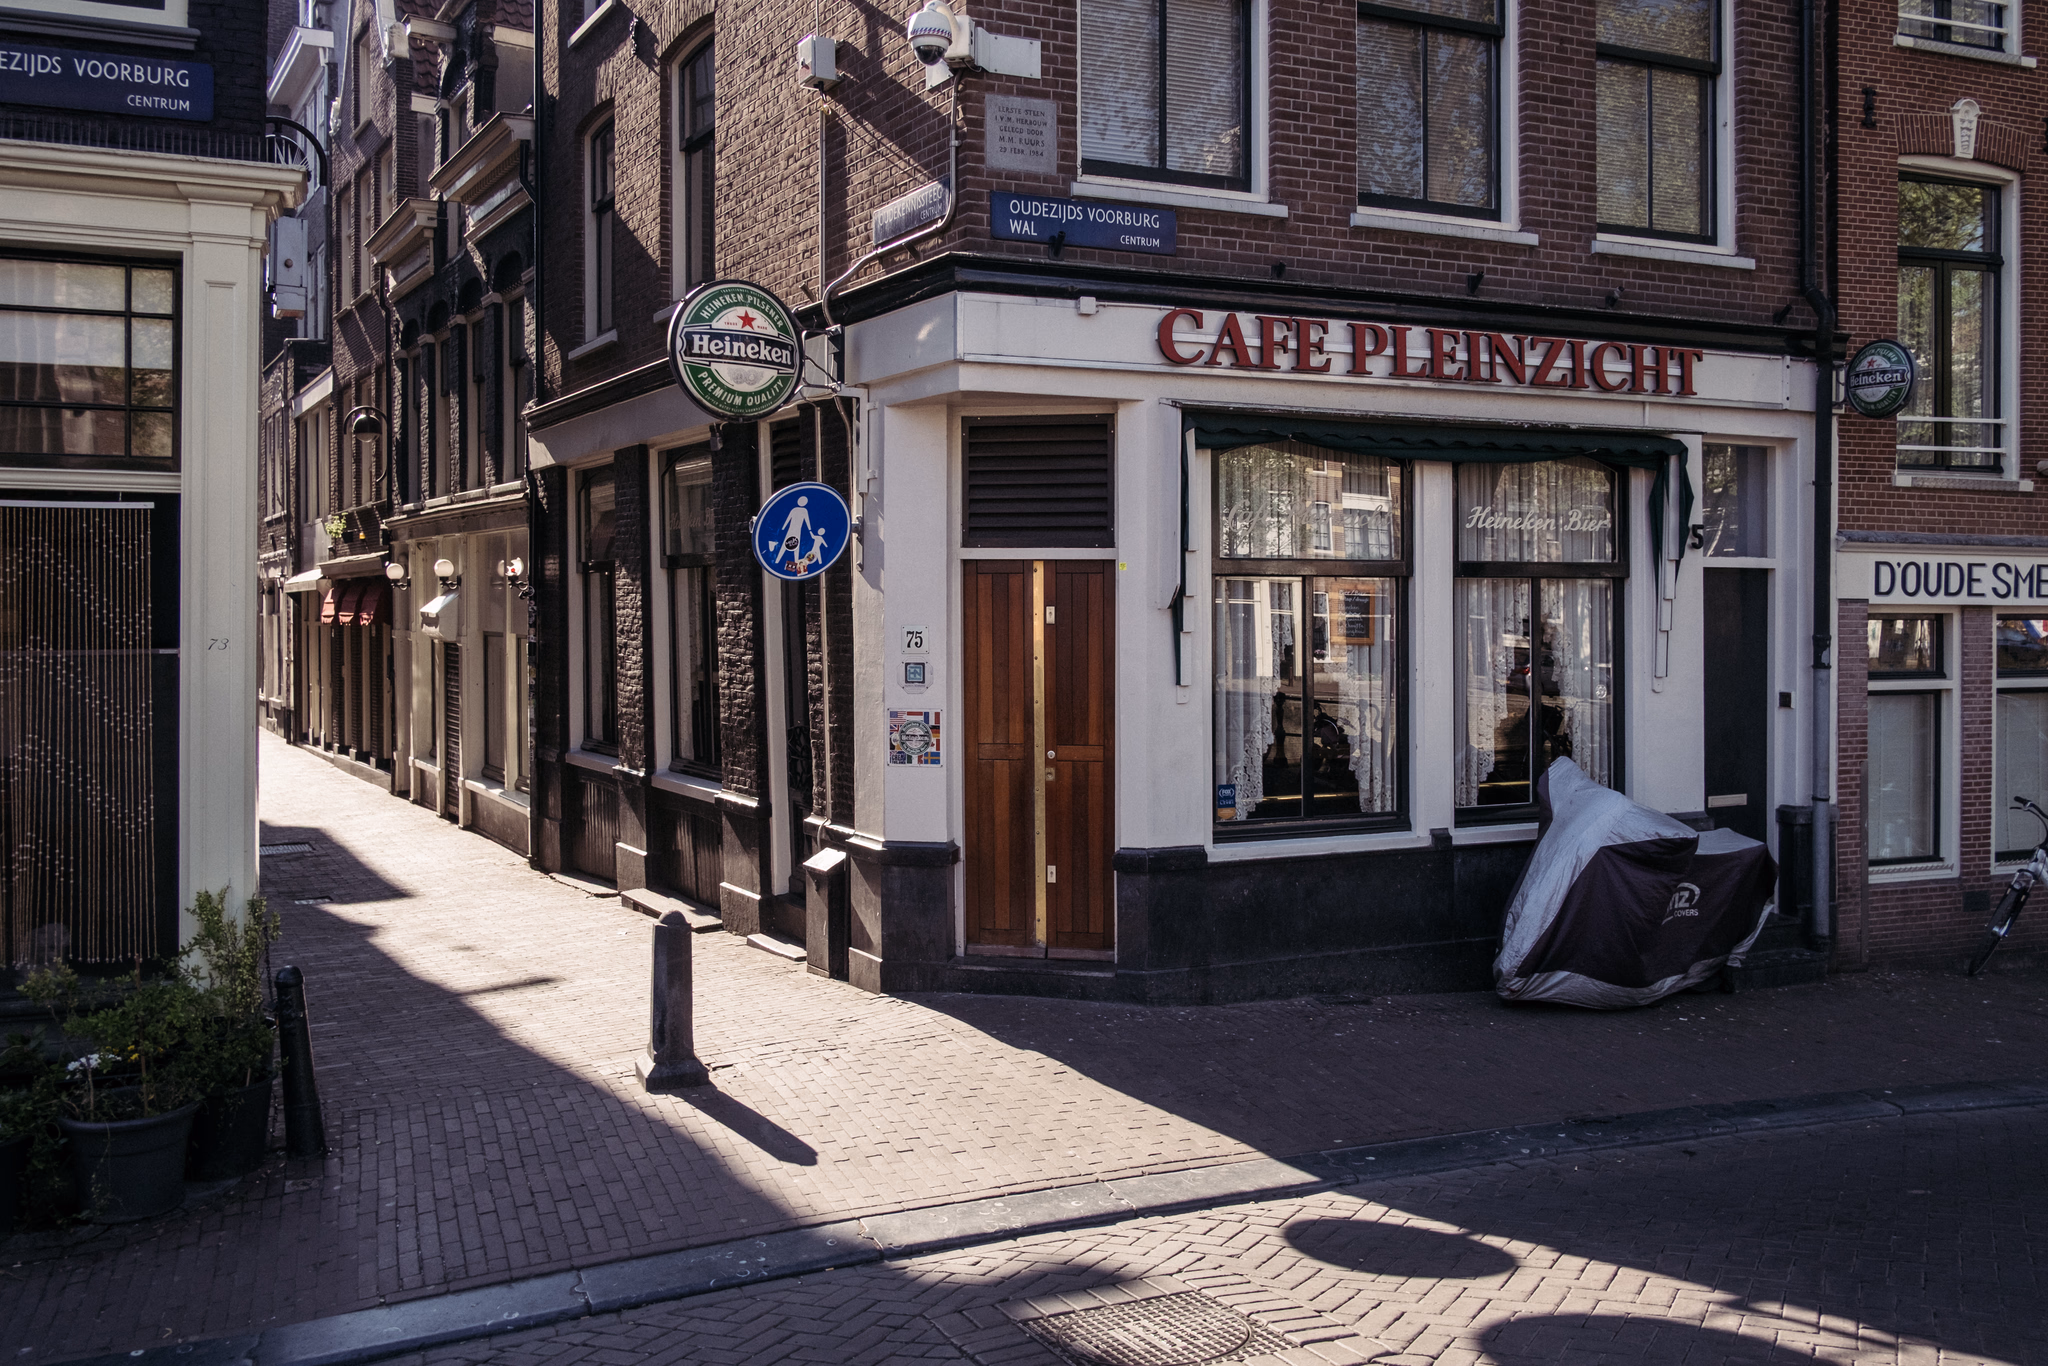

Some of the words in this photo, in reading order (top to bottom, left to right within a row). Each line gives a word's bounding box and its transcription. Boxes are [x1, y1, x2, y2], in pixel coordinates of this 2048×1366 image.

[74, 58, 190, 88] VOORBURG
[127, 95, 190, 112] CENTRUM
[1024, 109, 1045, 117] STEEN
[1000, 125, 1023, 134] GELEGD
[1027, 128, 1044, 136] DOOR
[1016, 118, 1047, 127] HERBOUW
[1019, 138, 1045, 148] RUURS
[920, 203, 943, 220] CENTRUM
[1009, 200, 1083, 223] OUDEZIJDS
[1087, 207, 1160, 229] VOORBURG
[1009, 219, 1038, 236] WAL
[1120, 235, 1160, 248] CENTRUM
[700, 293, 745, 319] HEINEKEN
[747, 294, 784, 328] PILSENER
[691, 335, 791, 365] Heineken
[1158, 308, 1330, 373] CAFE
[1347, 322, 1703, 396] PLEINZICHT
[1850, 372, 1902, 387] Heineken
[698, 371, 743, 406] PREMIUM
[746, 379, 784, 406] QUALITY
[1877, 390, 1898, 409] QUALITY
[1465, 505, 1556, 531] Heineken
[1563, 508, 1612, 532] Bier
[1691, 523, 1705, 550] 5
[1874, 561, 1987, 598] D'OUDE
[1991, 562, 2048, 599] SME
[208, 638, 229, 650] 73
[906, 630, 923, 648] 75
[1674, 909, 1699, 917] COVERS
